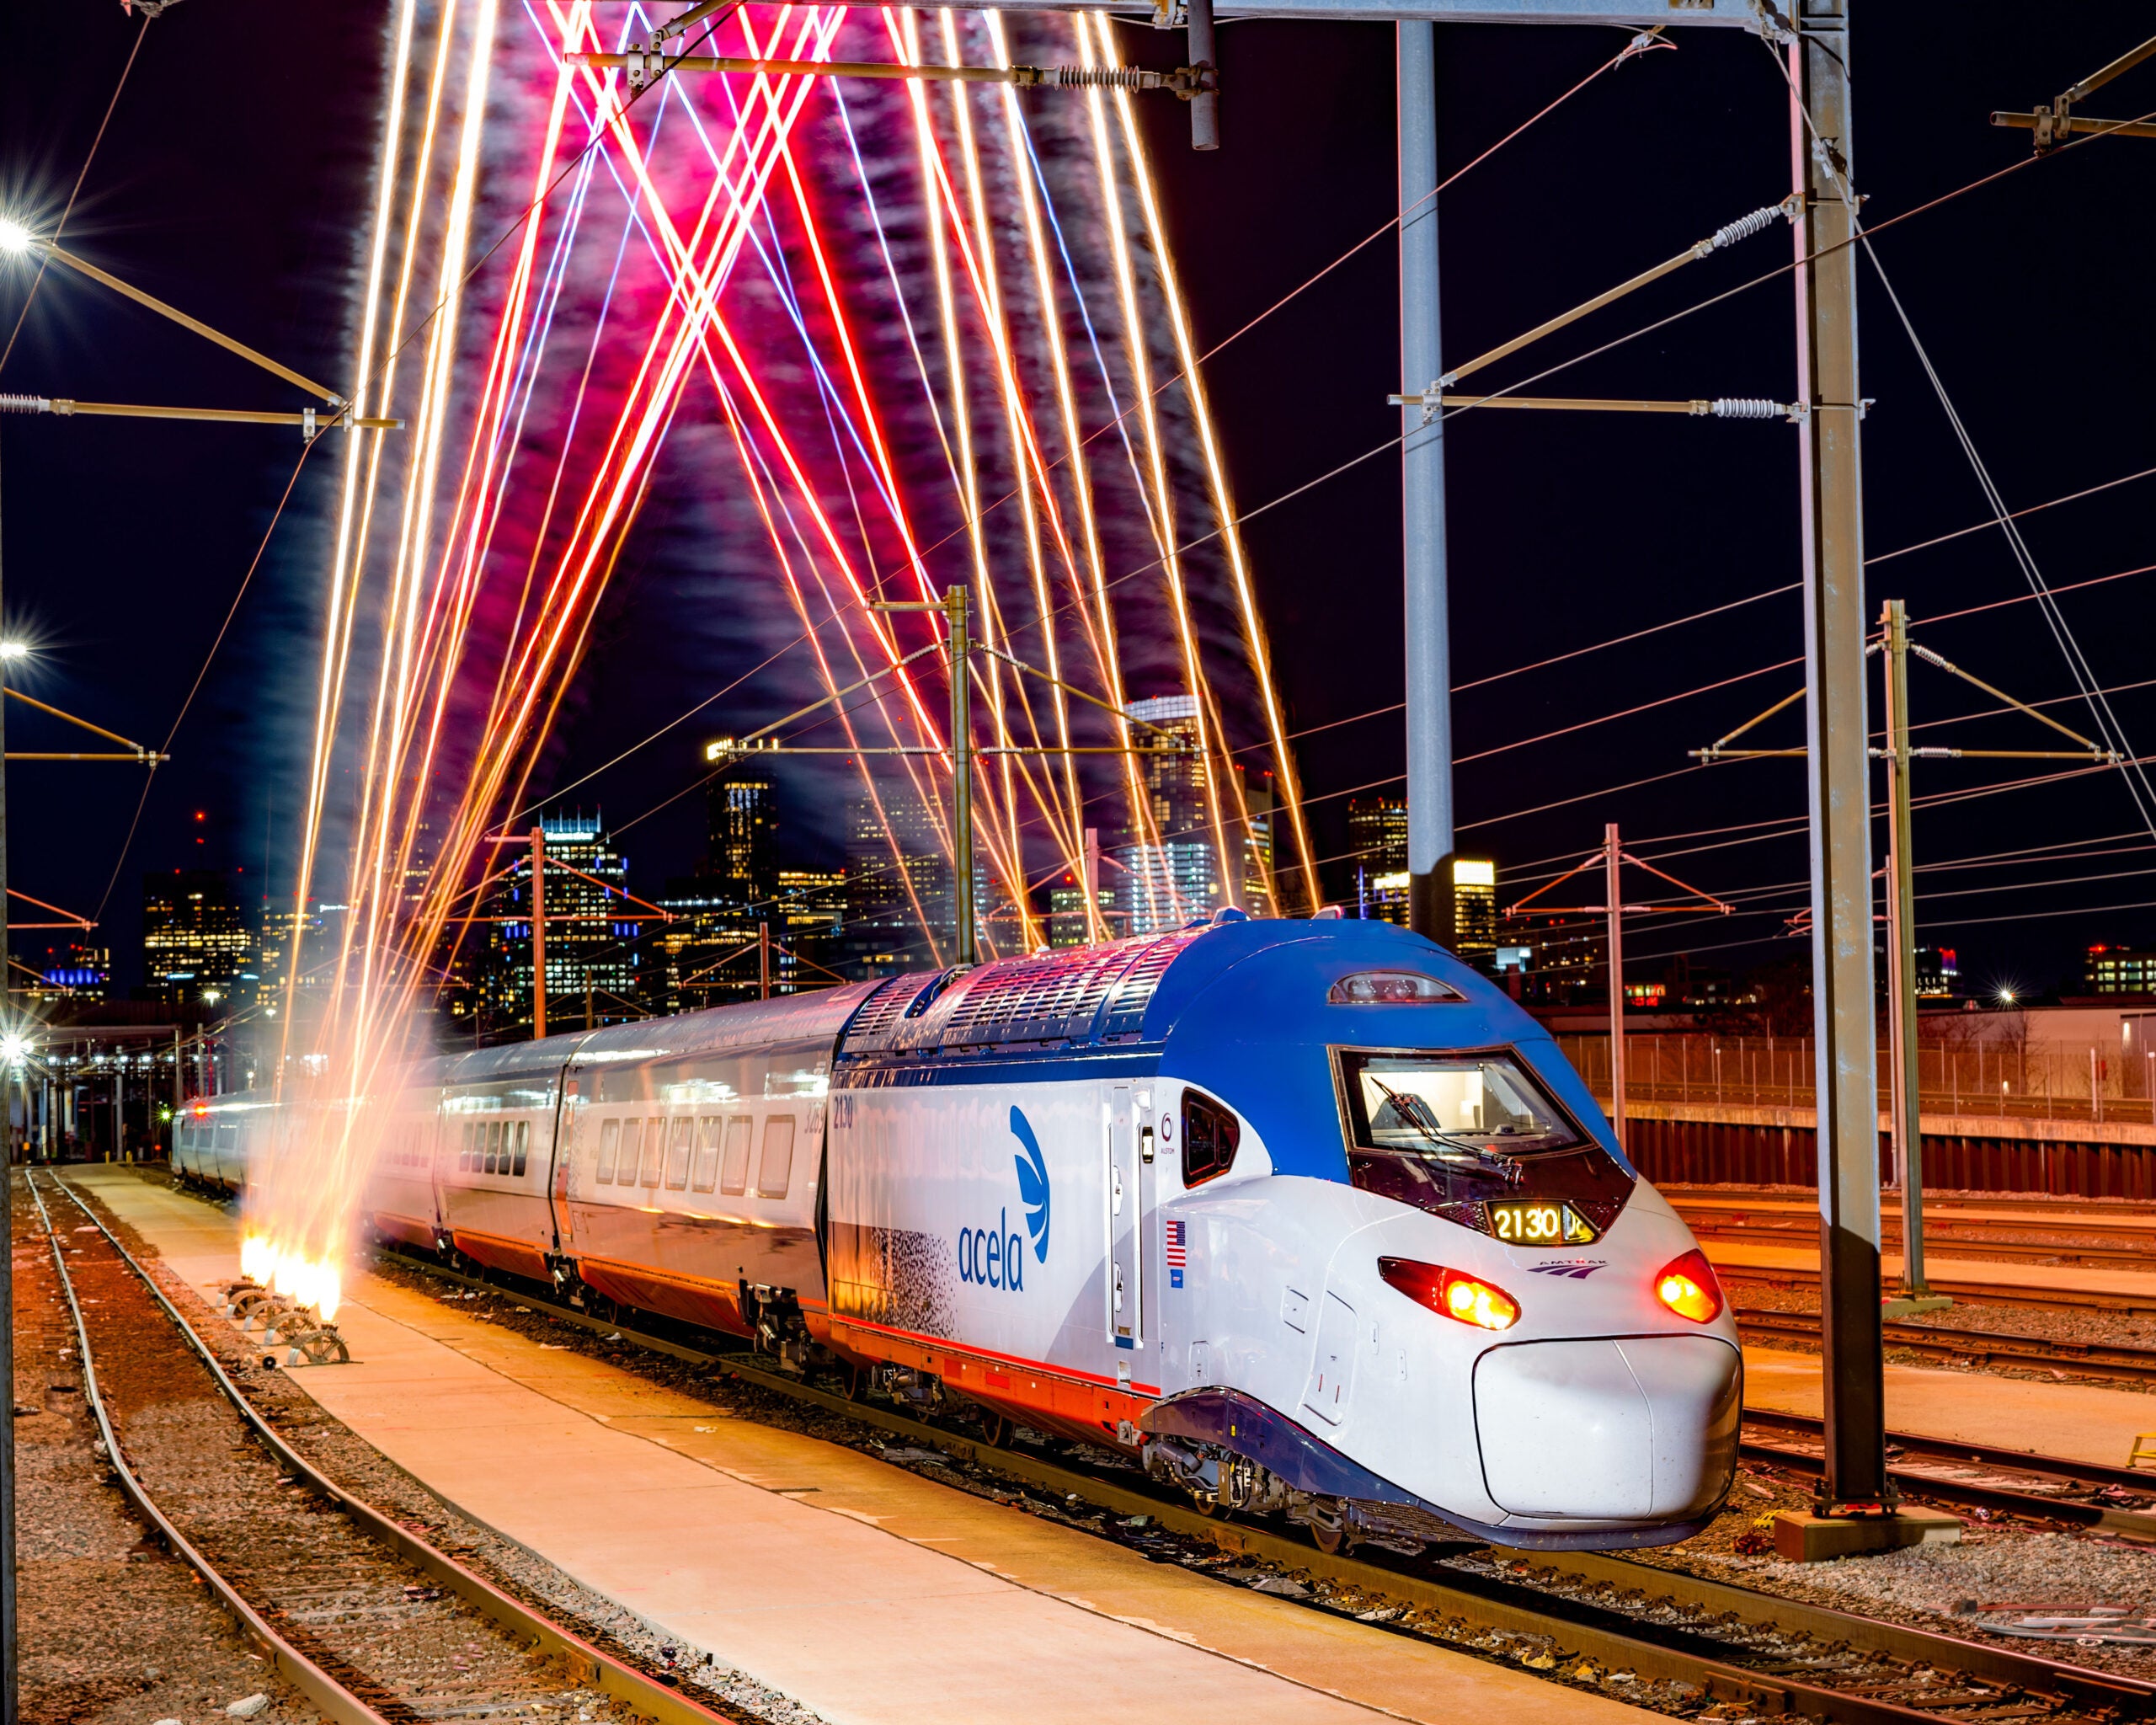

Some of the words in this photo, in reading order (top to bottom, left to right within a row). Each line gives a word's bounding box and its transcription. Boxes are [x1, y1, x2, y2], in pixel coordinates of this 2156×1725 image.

[834, 1095, 853, 1129] 2130
[1495, 1209, 1559, 1237] 2130
[958, 1206, 1023, 1292] acela
